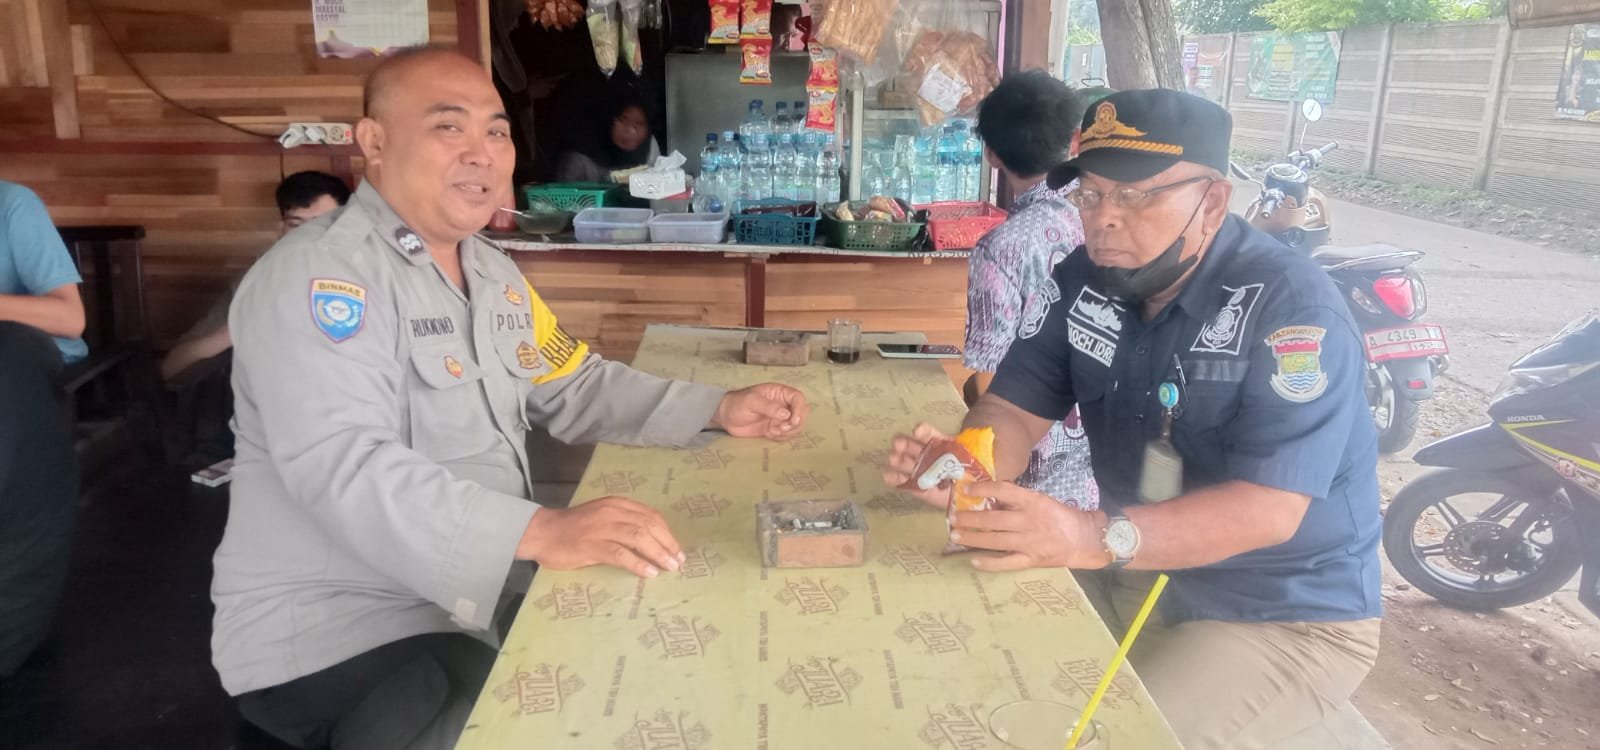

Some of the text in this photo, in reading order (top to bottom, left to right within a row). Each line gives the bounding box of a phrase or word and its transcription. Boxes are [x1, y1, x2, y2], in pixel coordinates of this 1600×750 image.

[317, 282, 362, 298] BINMAS
[1387, 328, 1417, 342] 4349
[1507, 415, 1545, 423] HONDA
